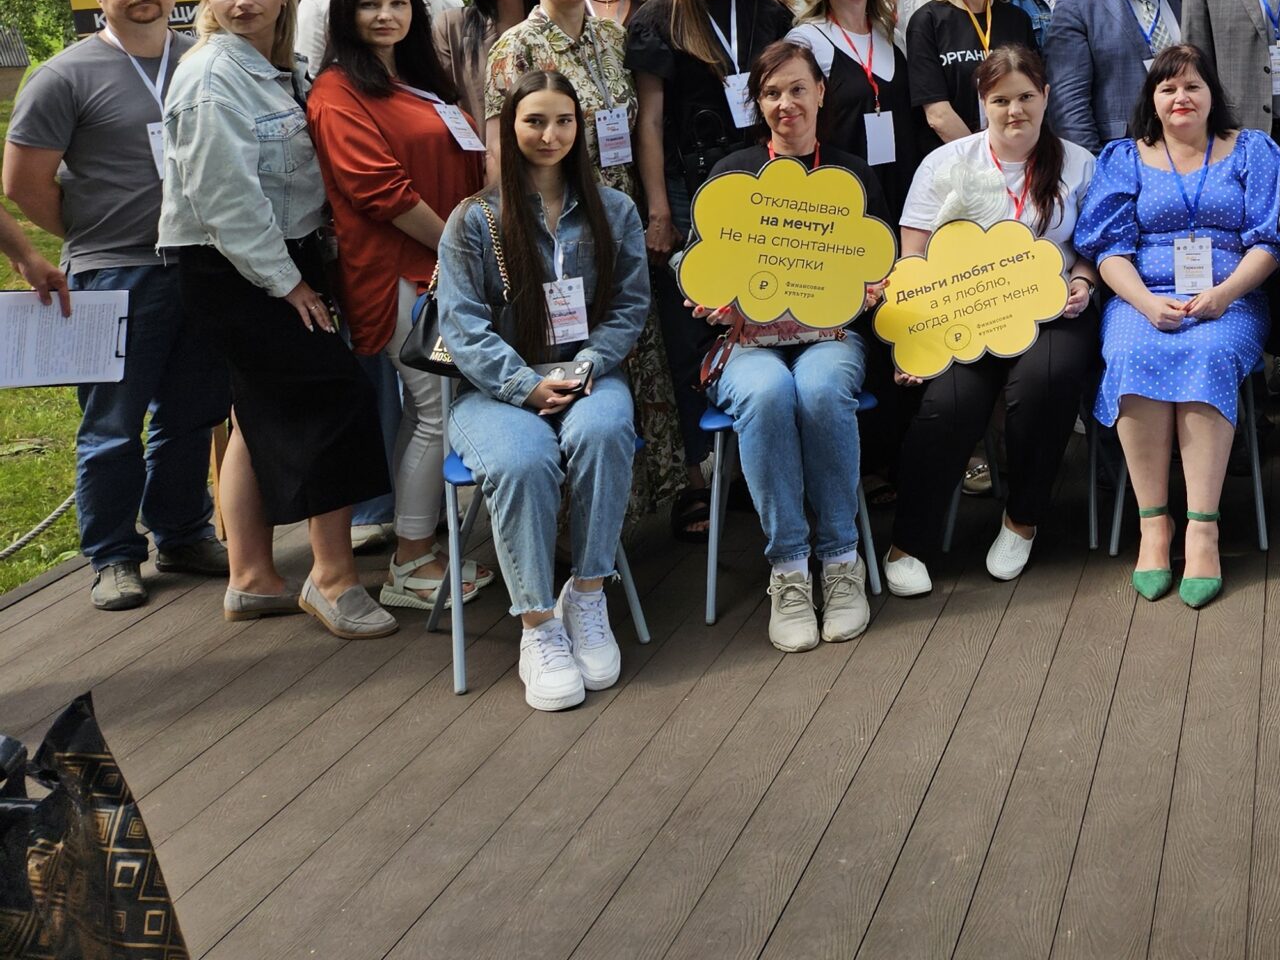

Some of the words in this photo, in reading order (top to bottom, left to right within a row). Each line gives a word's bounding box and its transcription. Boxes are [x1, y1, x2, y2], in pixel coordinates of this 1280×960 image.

[750, 192, 850, 217] Откладываю
[760, 215, 778, 226] на
[783, 218, 835, 236] мечту!
[719, 227, 743, 242] Не
[747, 233, 766, 245] на
[771, 236, 866, 257] спонтанные
[757, 254, 823, 271] покупки
[895, 278, 948, 305] Деньги
[951, 260, 996, 285] любят
[999, 250, 1036, 268] счет,
[784, 290, 815, 298] культура
[930, 299, 939, 310] а
[942, 295, 951, 305] я
[955, 276, 1011, 302] люблю,
[908, 313, 949, 335] когда
[953, 296, 998, 320] любят
[1003, 283, 1039, 303] меня
[978, 323, 1007, 336] культура
